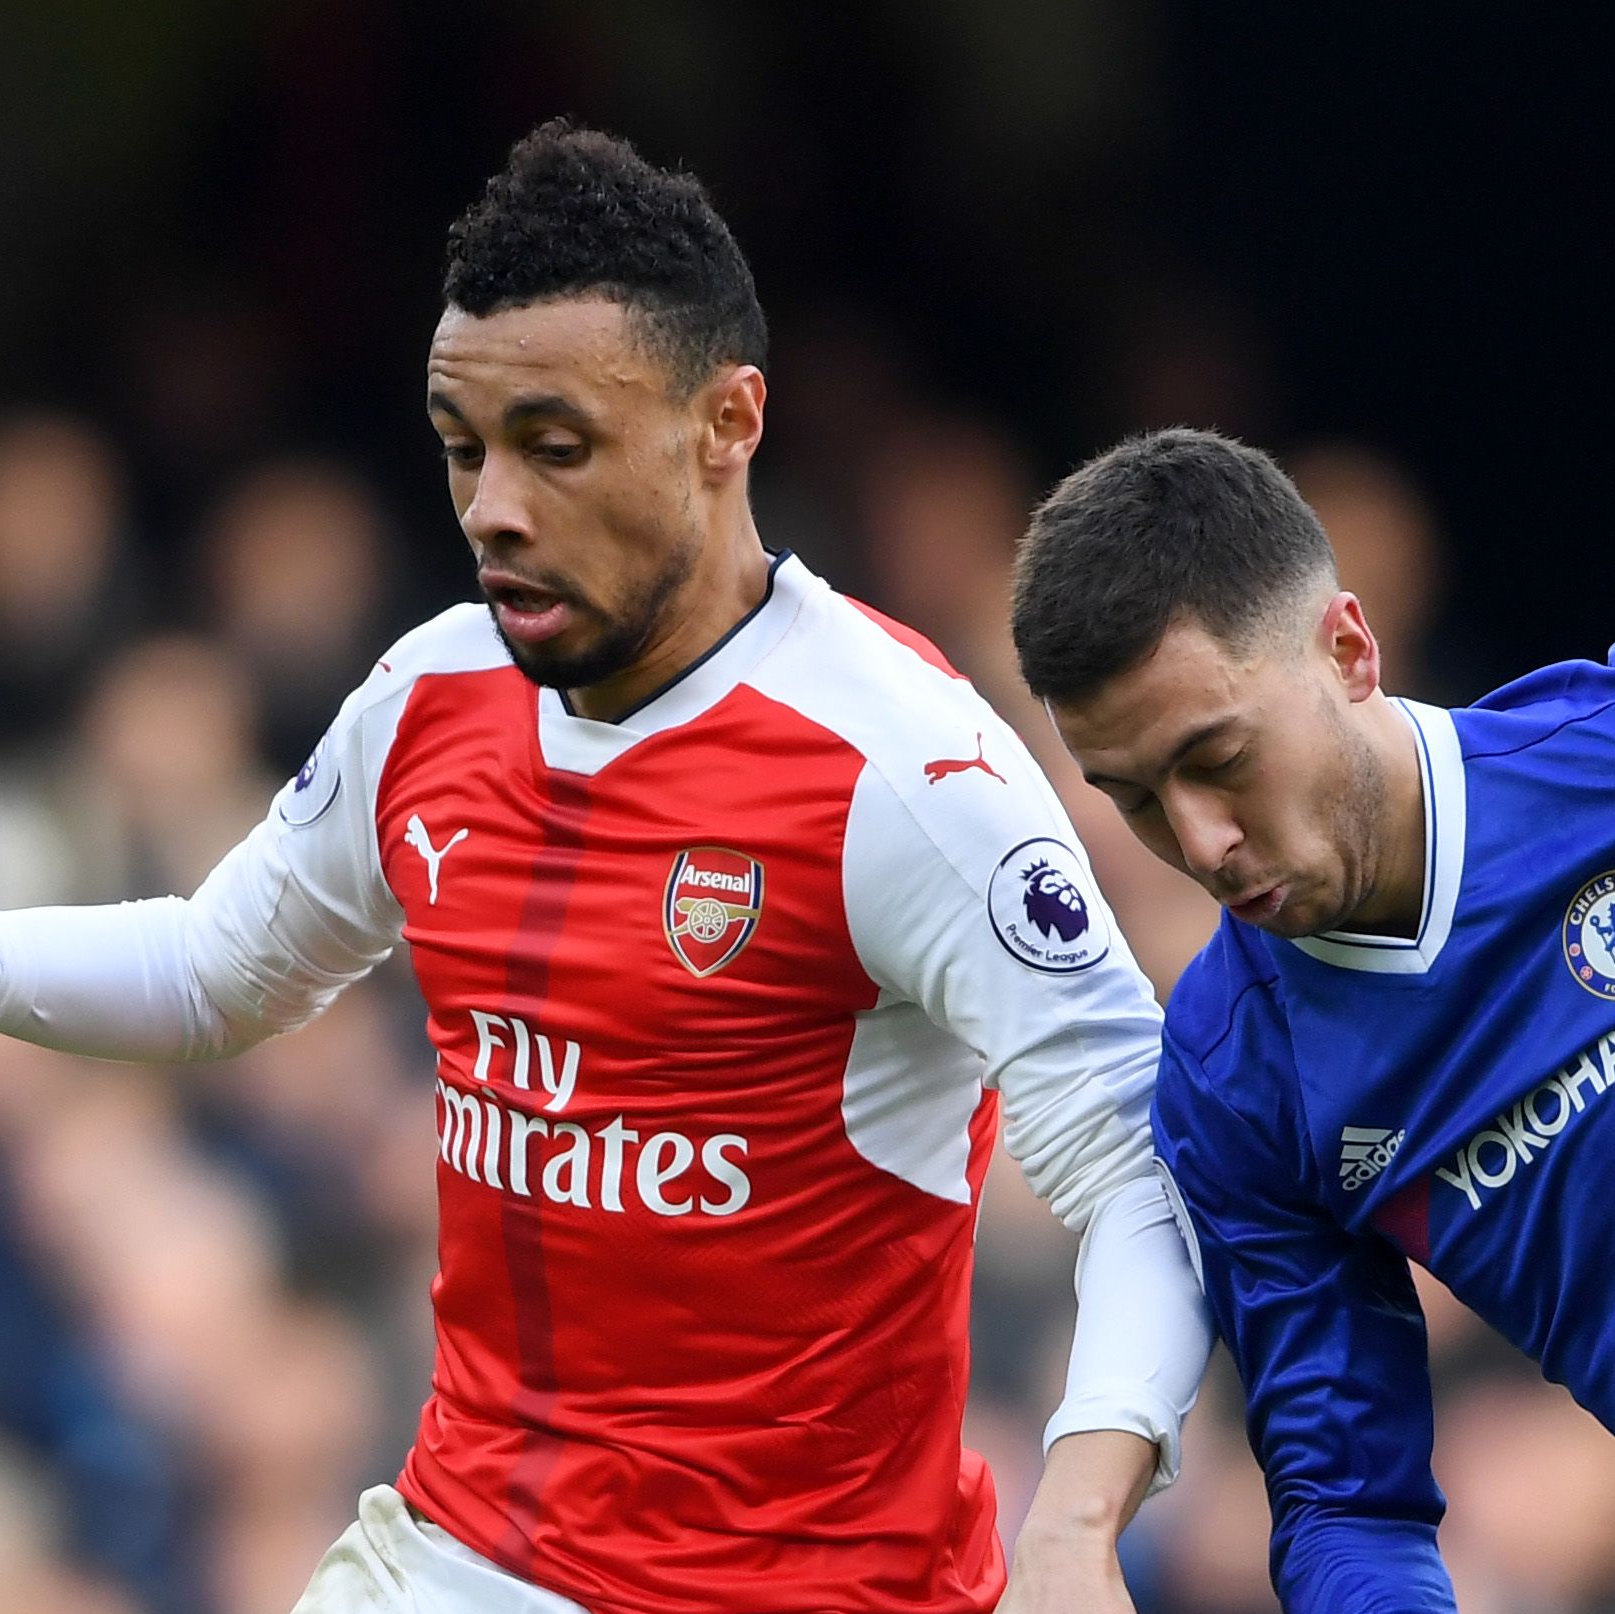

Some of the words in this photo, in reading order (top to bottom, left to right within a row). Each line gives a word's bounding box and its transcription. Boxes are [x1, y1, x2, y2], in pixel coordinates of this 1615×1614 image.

[680, 865, 750, 893] Arsenal
[1006, 923, 1043, 956] Premier
[1045, 949, 1088, 963] League
[470, 1009, 581, 1112] Fly
[436, 1078, 751, 1216] mirates
